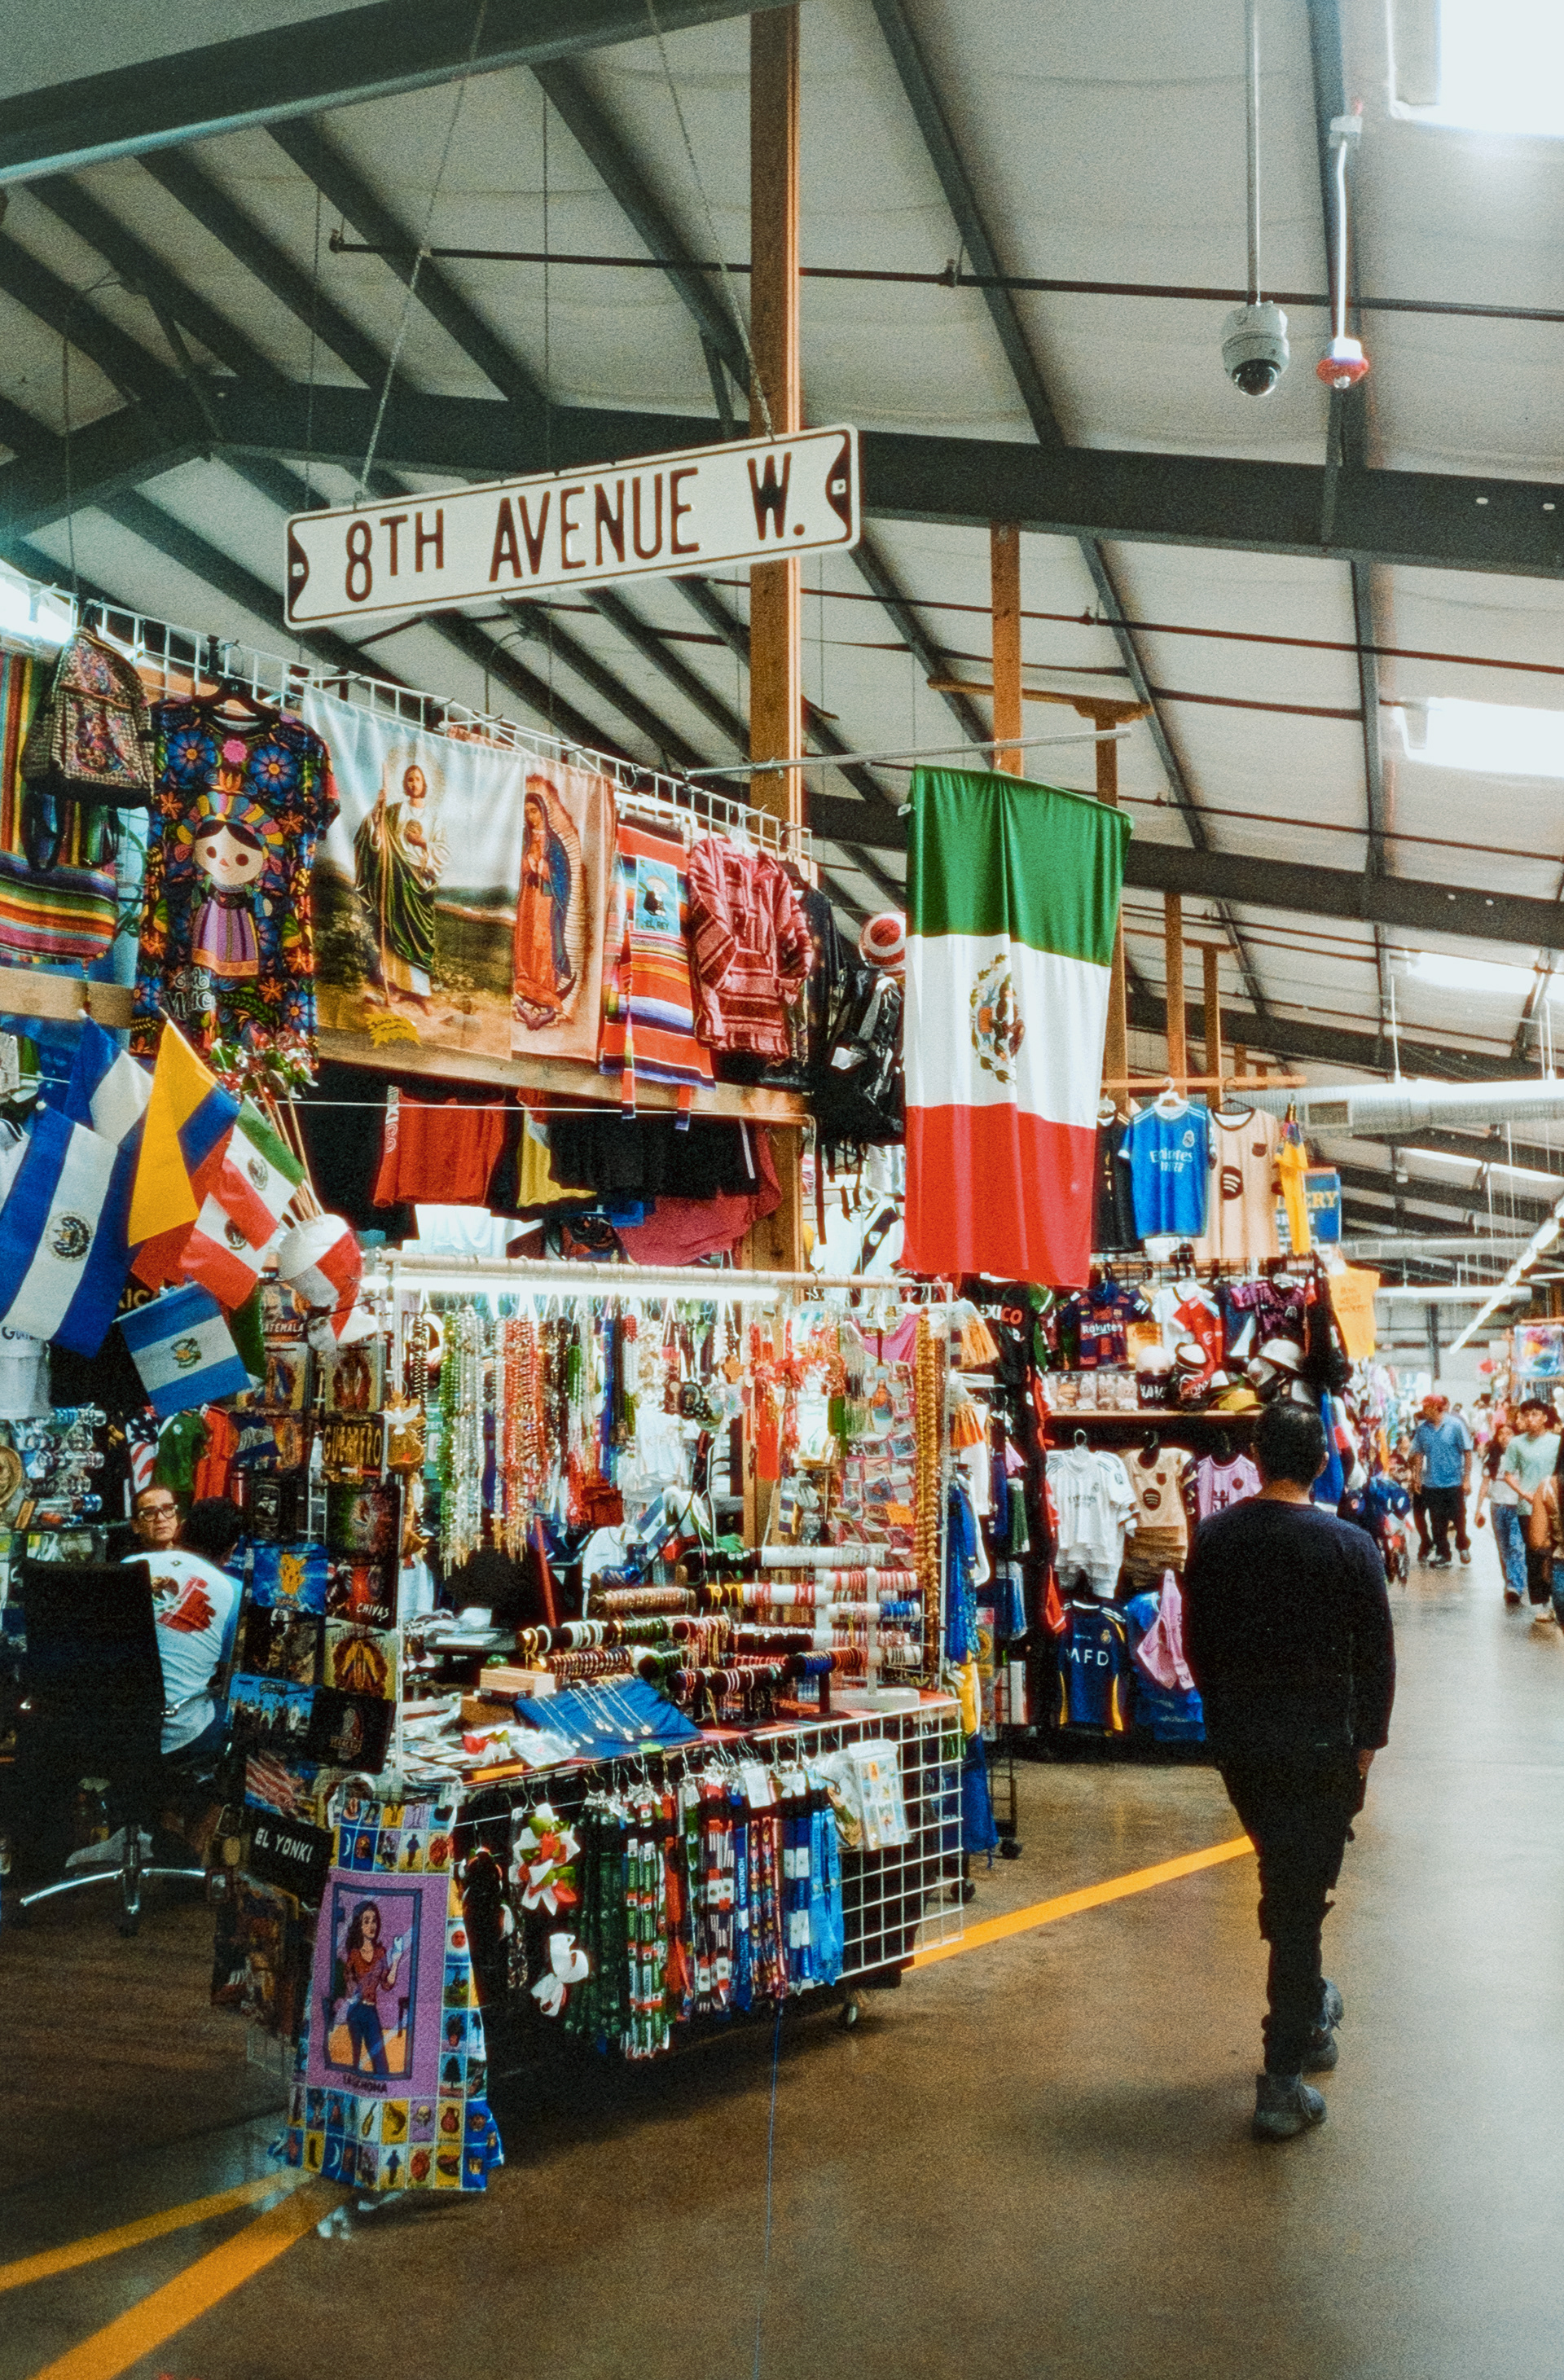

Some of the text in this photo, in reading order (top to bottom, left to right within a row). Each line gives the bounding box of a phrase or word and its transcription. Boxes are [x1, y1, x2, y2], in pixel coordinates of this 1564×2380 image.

[345, 451, 806, 602] 8TH AVENUE W.
[980, 1304, 1022, 1324] EXICO
[1081, 1323, 1123, 1337] Rakuten
[356, 1602, 389, 1621] CHIVAS
[255, 1827, 314, 1864] EL YONKI
[737, 1857, 747, 1905] HONDURAS
